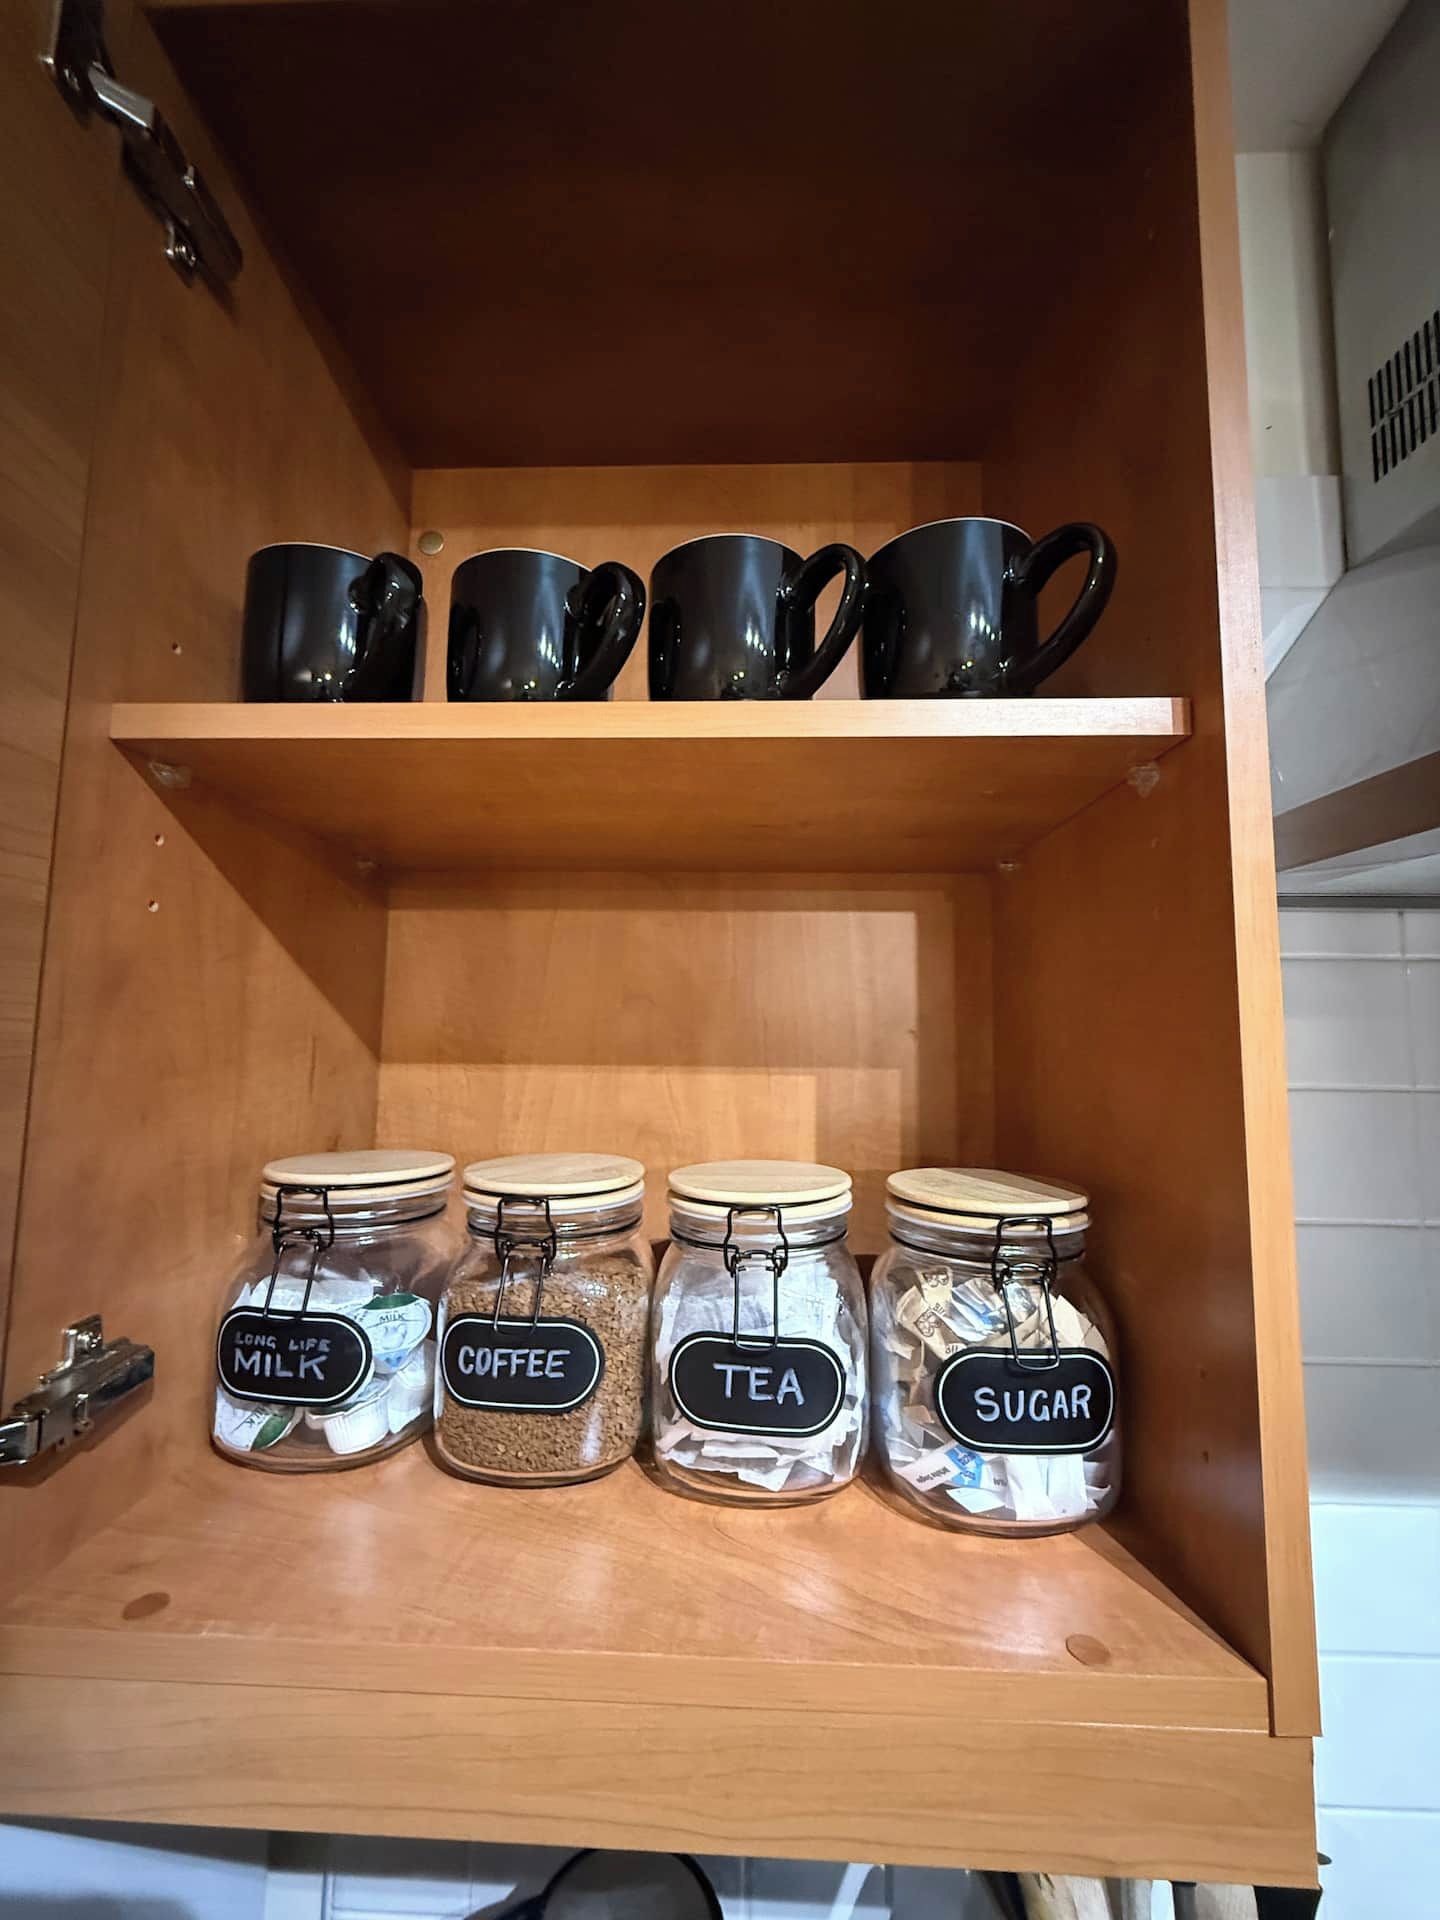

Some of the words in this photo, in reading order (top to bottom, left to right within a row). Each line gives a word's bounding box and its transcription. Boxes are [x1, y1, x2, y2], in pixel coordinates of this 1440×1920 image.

[235, 1331, 277, 1350] LONG
[288, 1338, 331, 1352] LIFE
[234, 1347, 328, 1380] MILK
[458, 1345, 571, 1379] COFFEE
[713, 1363, 804, 1405] TEA
[974, 1384, 1092, 1422] SUGAR
